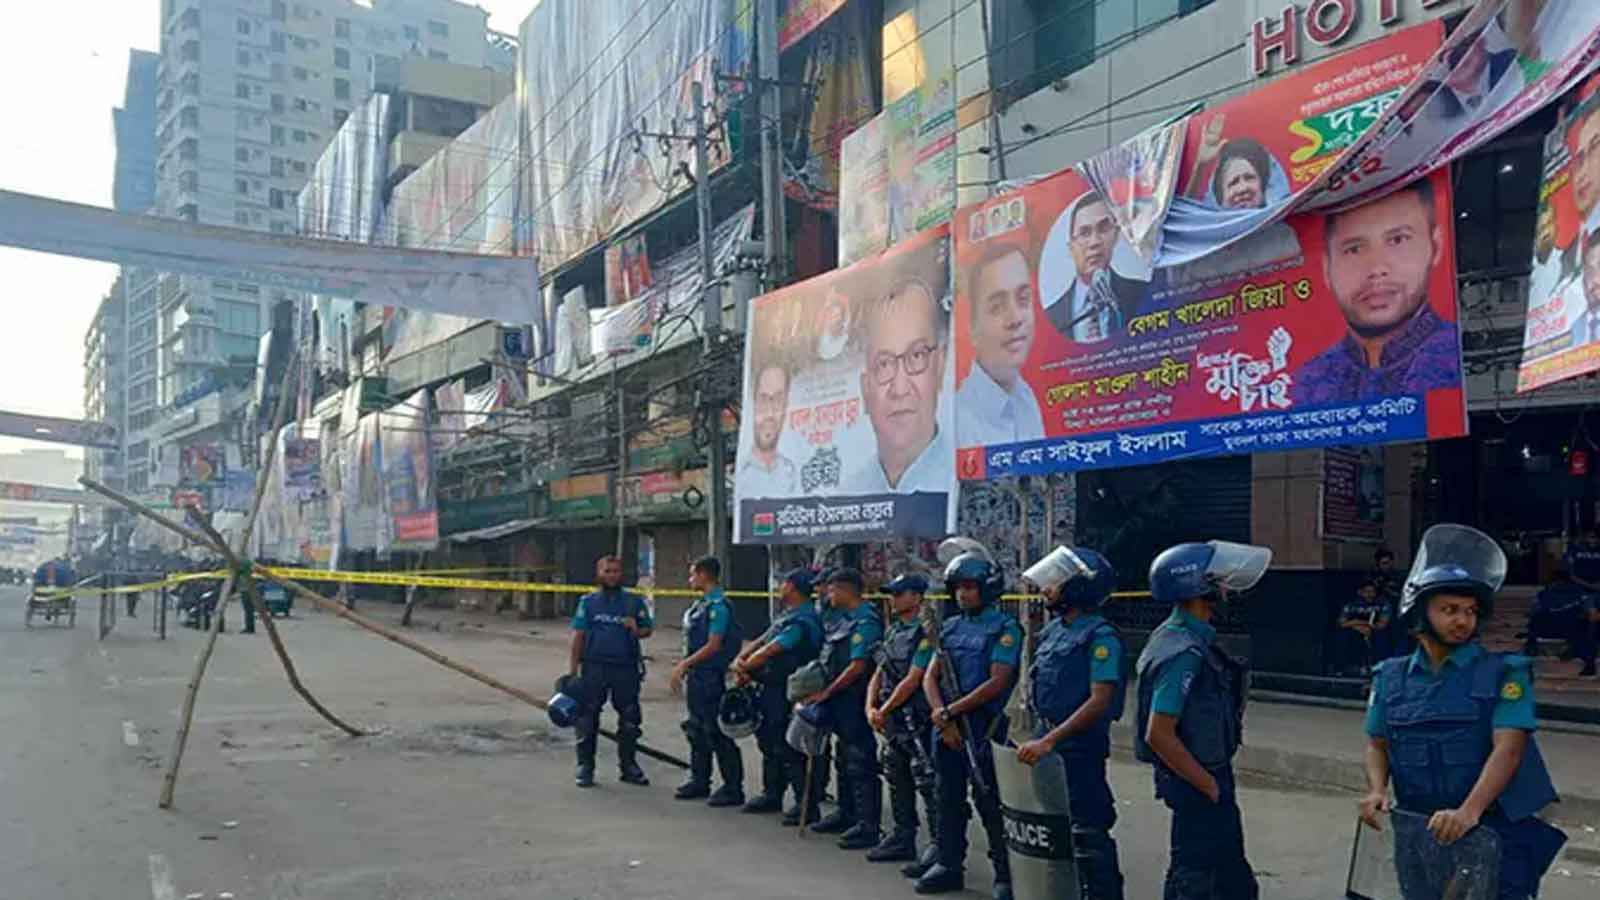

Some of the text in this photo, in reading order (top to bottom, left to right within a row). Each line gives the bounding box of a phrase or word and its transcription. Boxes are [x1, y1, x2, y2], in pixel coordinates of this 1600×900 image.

[1175, 294, 1235, 326] খালেদা
[1240, 281, 1286, 313] জিয়া
[1292, 278, 1312, 300] ও
[1205, 352, 1271, 401] মুক্তি
[1239, 374, 1293, 411] চাই
[1199, 421, 1243, 436] সাবেক
[1366, 396, 1418, 417] কমিটি
[989, 429, 1188, 468] এম এম সাইফুল ইসলাম
